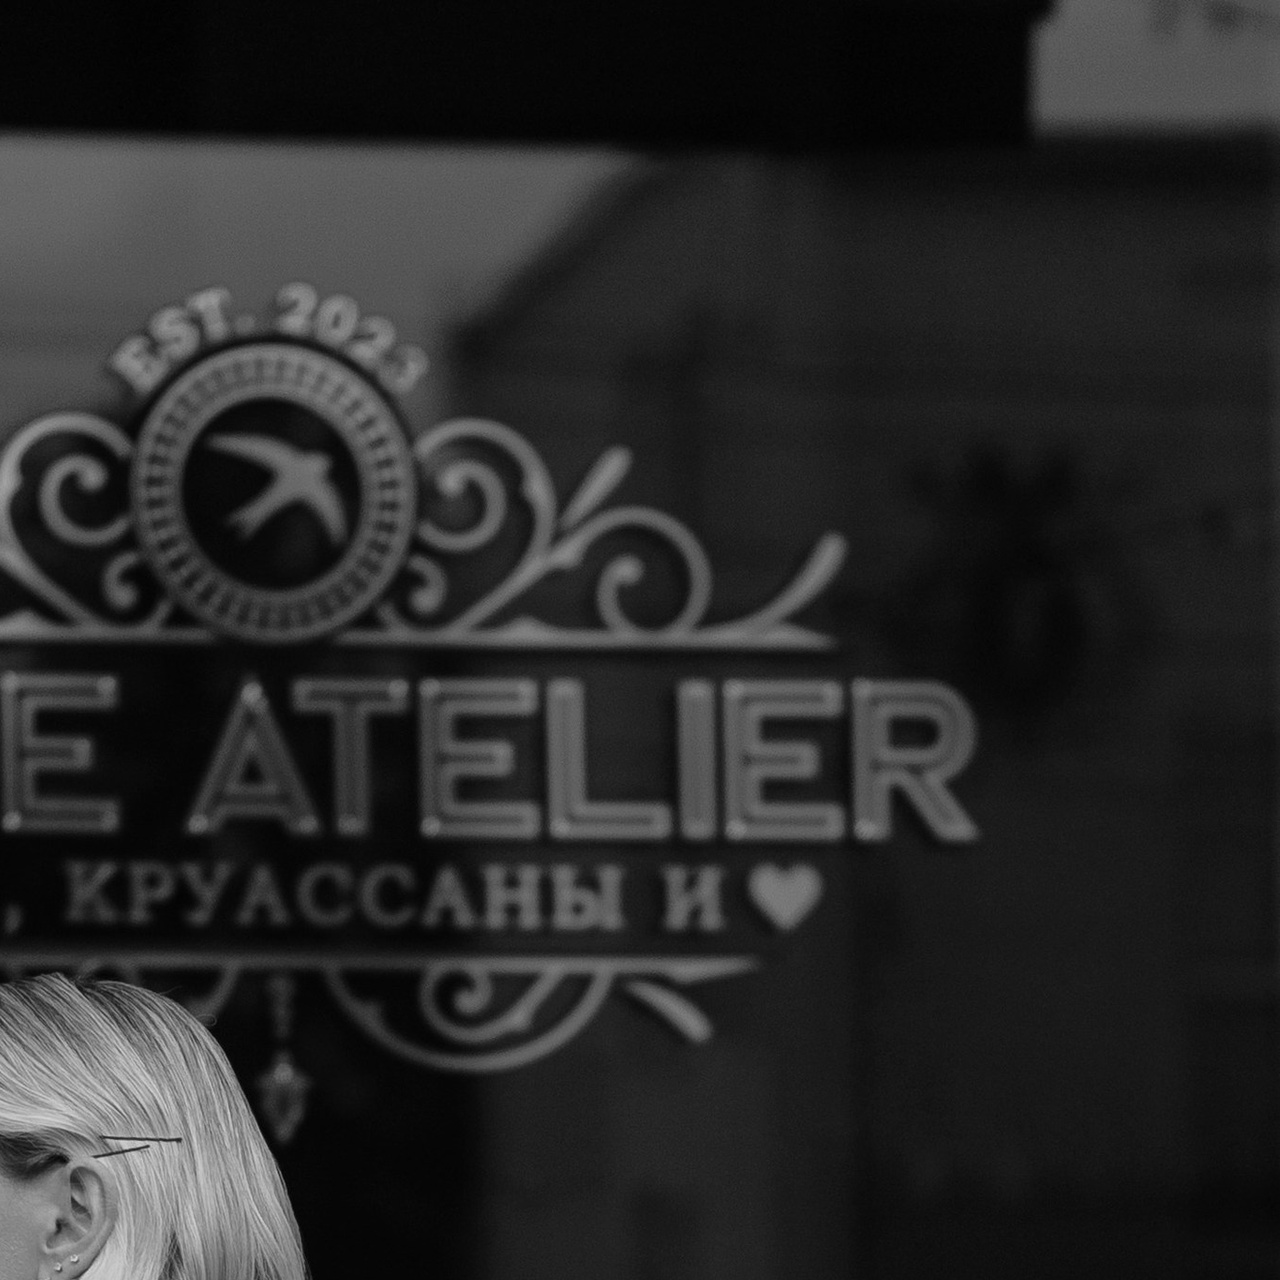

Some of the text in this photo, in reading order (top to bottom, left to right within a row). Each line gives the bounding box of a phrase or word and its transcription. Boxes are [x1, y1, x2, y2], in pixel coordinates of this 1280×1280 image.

[111, 286, 257, 393] EST.
[183, 676, 981, 841] ATELIER
[65, 858, 625, 932] КРУАССАНЫ
[662, 863, 725, 932] И
